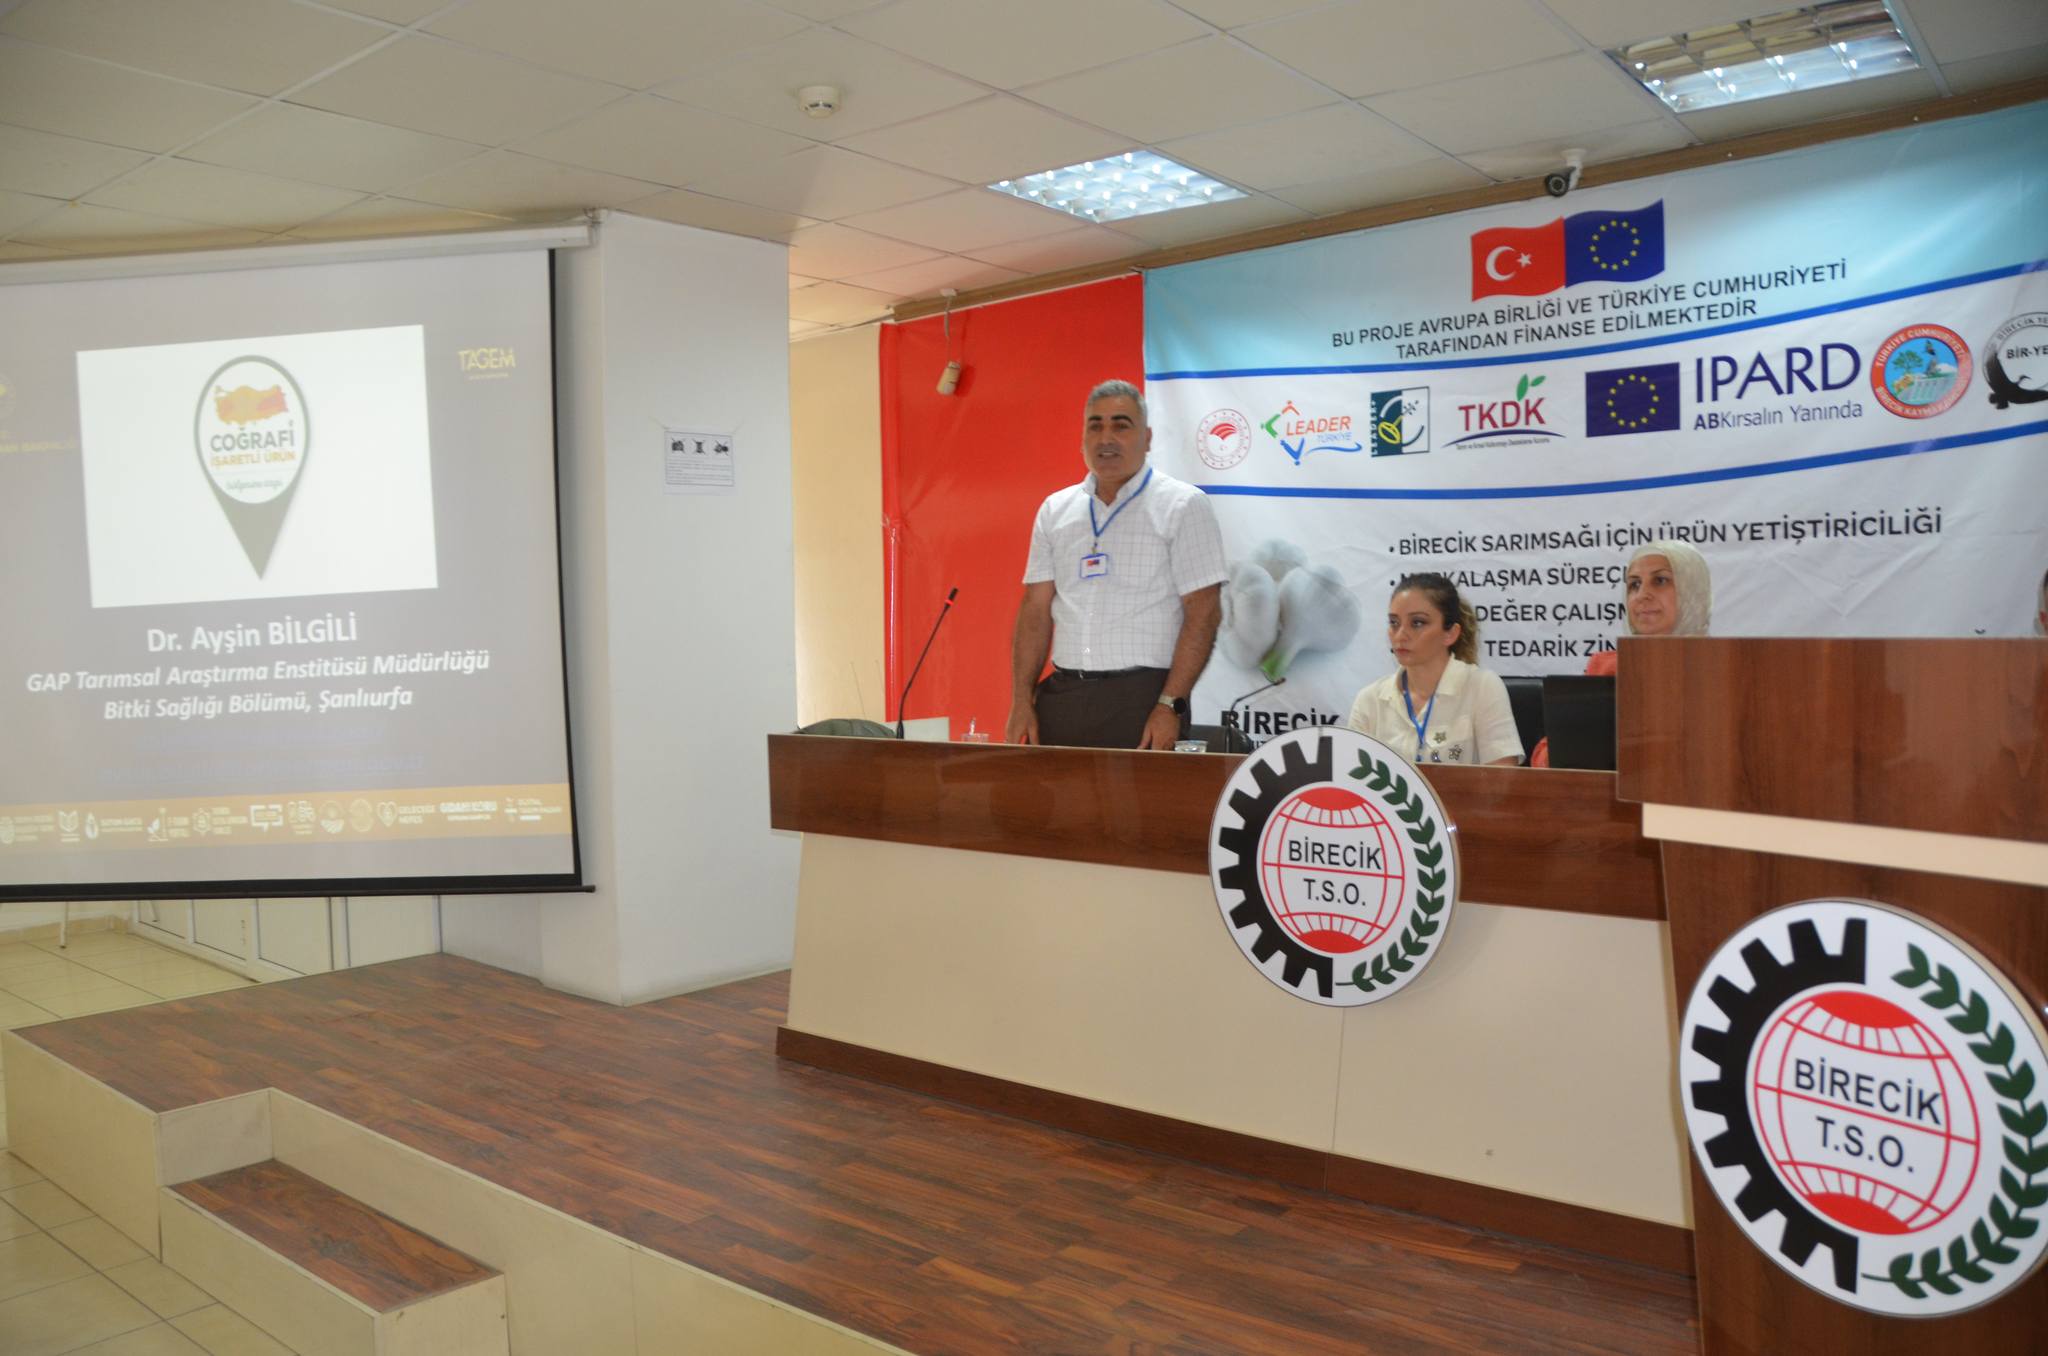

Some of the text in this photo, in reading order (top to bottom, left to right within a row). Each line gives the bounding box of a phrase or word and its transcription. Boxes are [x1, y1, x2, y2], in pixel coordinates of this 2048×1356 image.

[1332, 258, 1847, 348] BU PROJE AVRUPA BİRLİĞİ VE TÜRKİYE CUMHURİYETİ
[1396, 297, 1758, 359] TARAFINDAN FİNANSE EDİLMEKTEDİR
[458, 346, 516, 371] TAGEM
[1696, 343, 1861, 403] IPARD
[1286, 416, 1352, 436] LEADER
[1458, 397, 1546, 432] TKDK
[1790, 401, 1863, 423] Yanında
[210, 420, 295, 452] COĞRAFİ
[1399, 506, 1942, 555] BİRECİK SARIMSAĞI İÇİN ÜRÜN YETİŞTİRİCİLİĞİ
[1475, 598, 1547, 621] DEĞER
[147, 611, 358, 655] Dr. Ayşin BİLGİLİ
[1484, 633, 1578, 657] TEDARİK
[26, 649, 490, 692] GAP Tarımsal Araştırma Enstitüsü Müdürlüğü
[104, 685, 413, 720] Bitki Sağlığı Bölümü, Şanlıurfa
[1288, 836, 1382, 870] BİRECİK
[1303, 878, 1367, 907] T.S.O.
[1794, 1057, 1943, 1126] BİRECİK
[1815, 1115, 1915, 1173] T.S.O.
